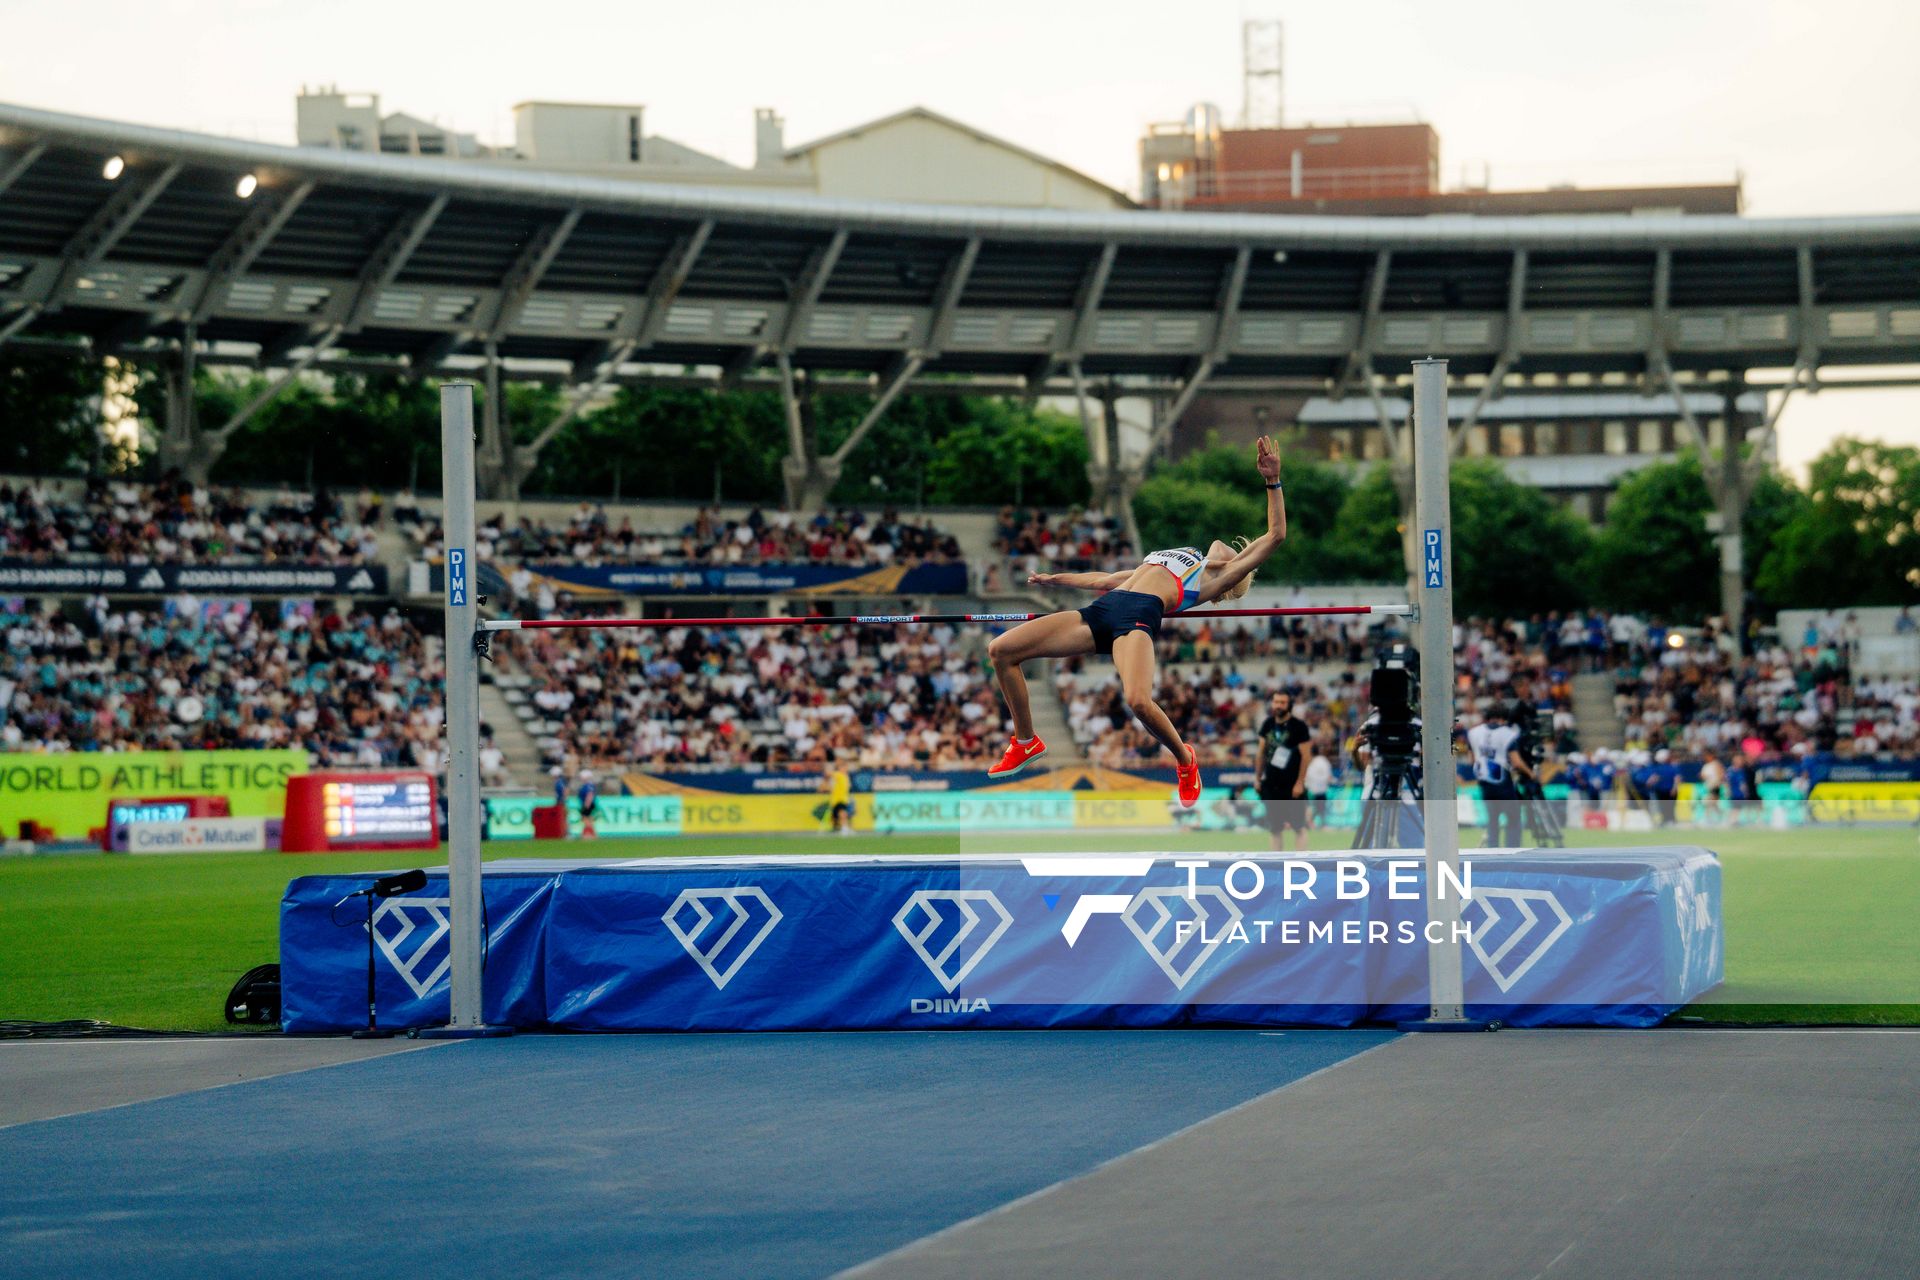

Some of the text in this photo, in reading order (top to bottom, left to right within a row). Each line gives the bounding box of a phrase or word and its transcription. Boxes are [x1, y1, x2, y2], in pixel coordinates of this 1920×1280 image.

[1426, 532, 1440, 586] DIMA
[451, 551, 464, 604] DIMA
[111, 763, 295, 790] ATHLETICS
[871, 799, 1137, 821] WORLD ATHLETICS
[911, 998, 991, 1013] DIMA
